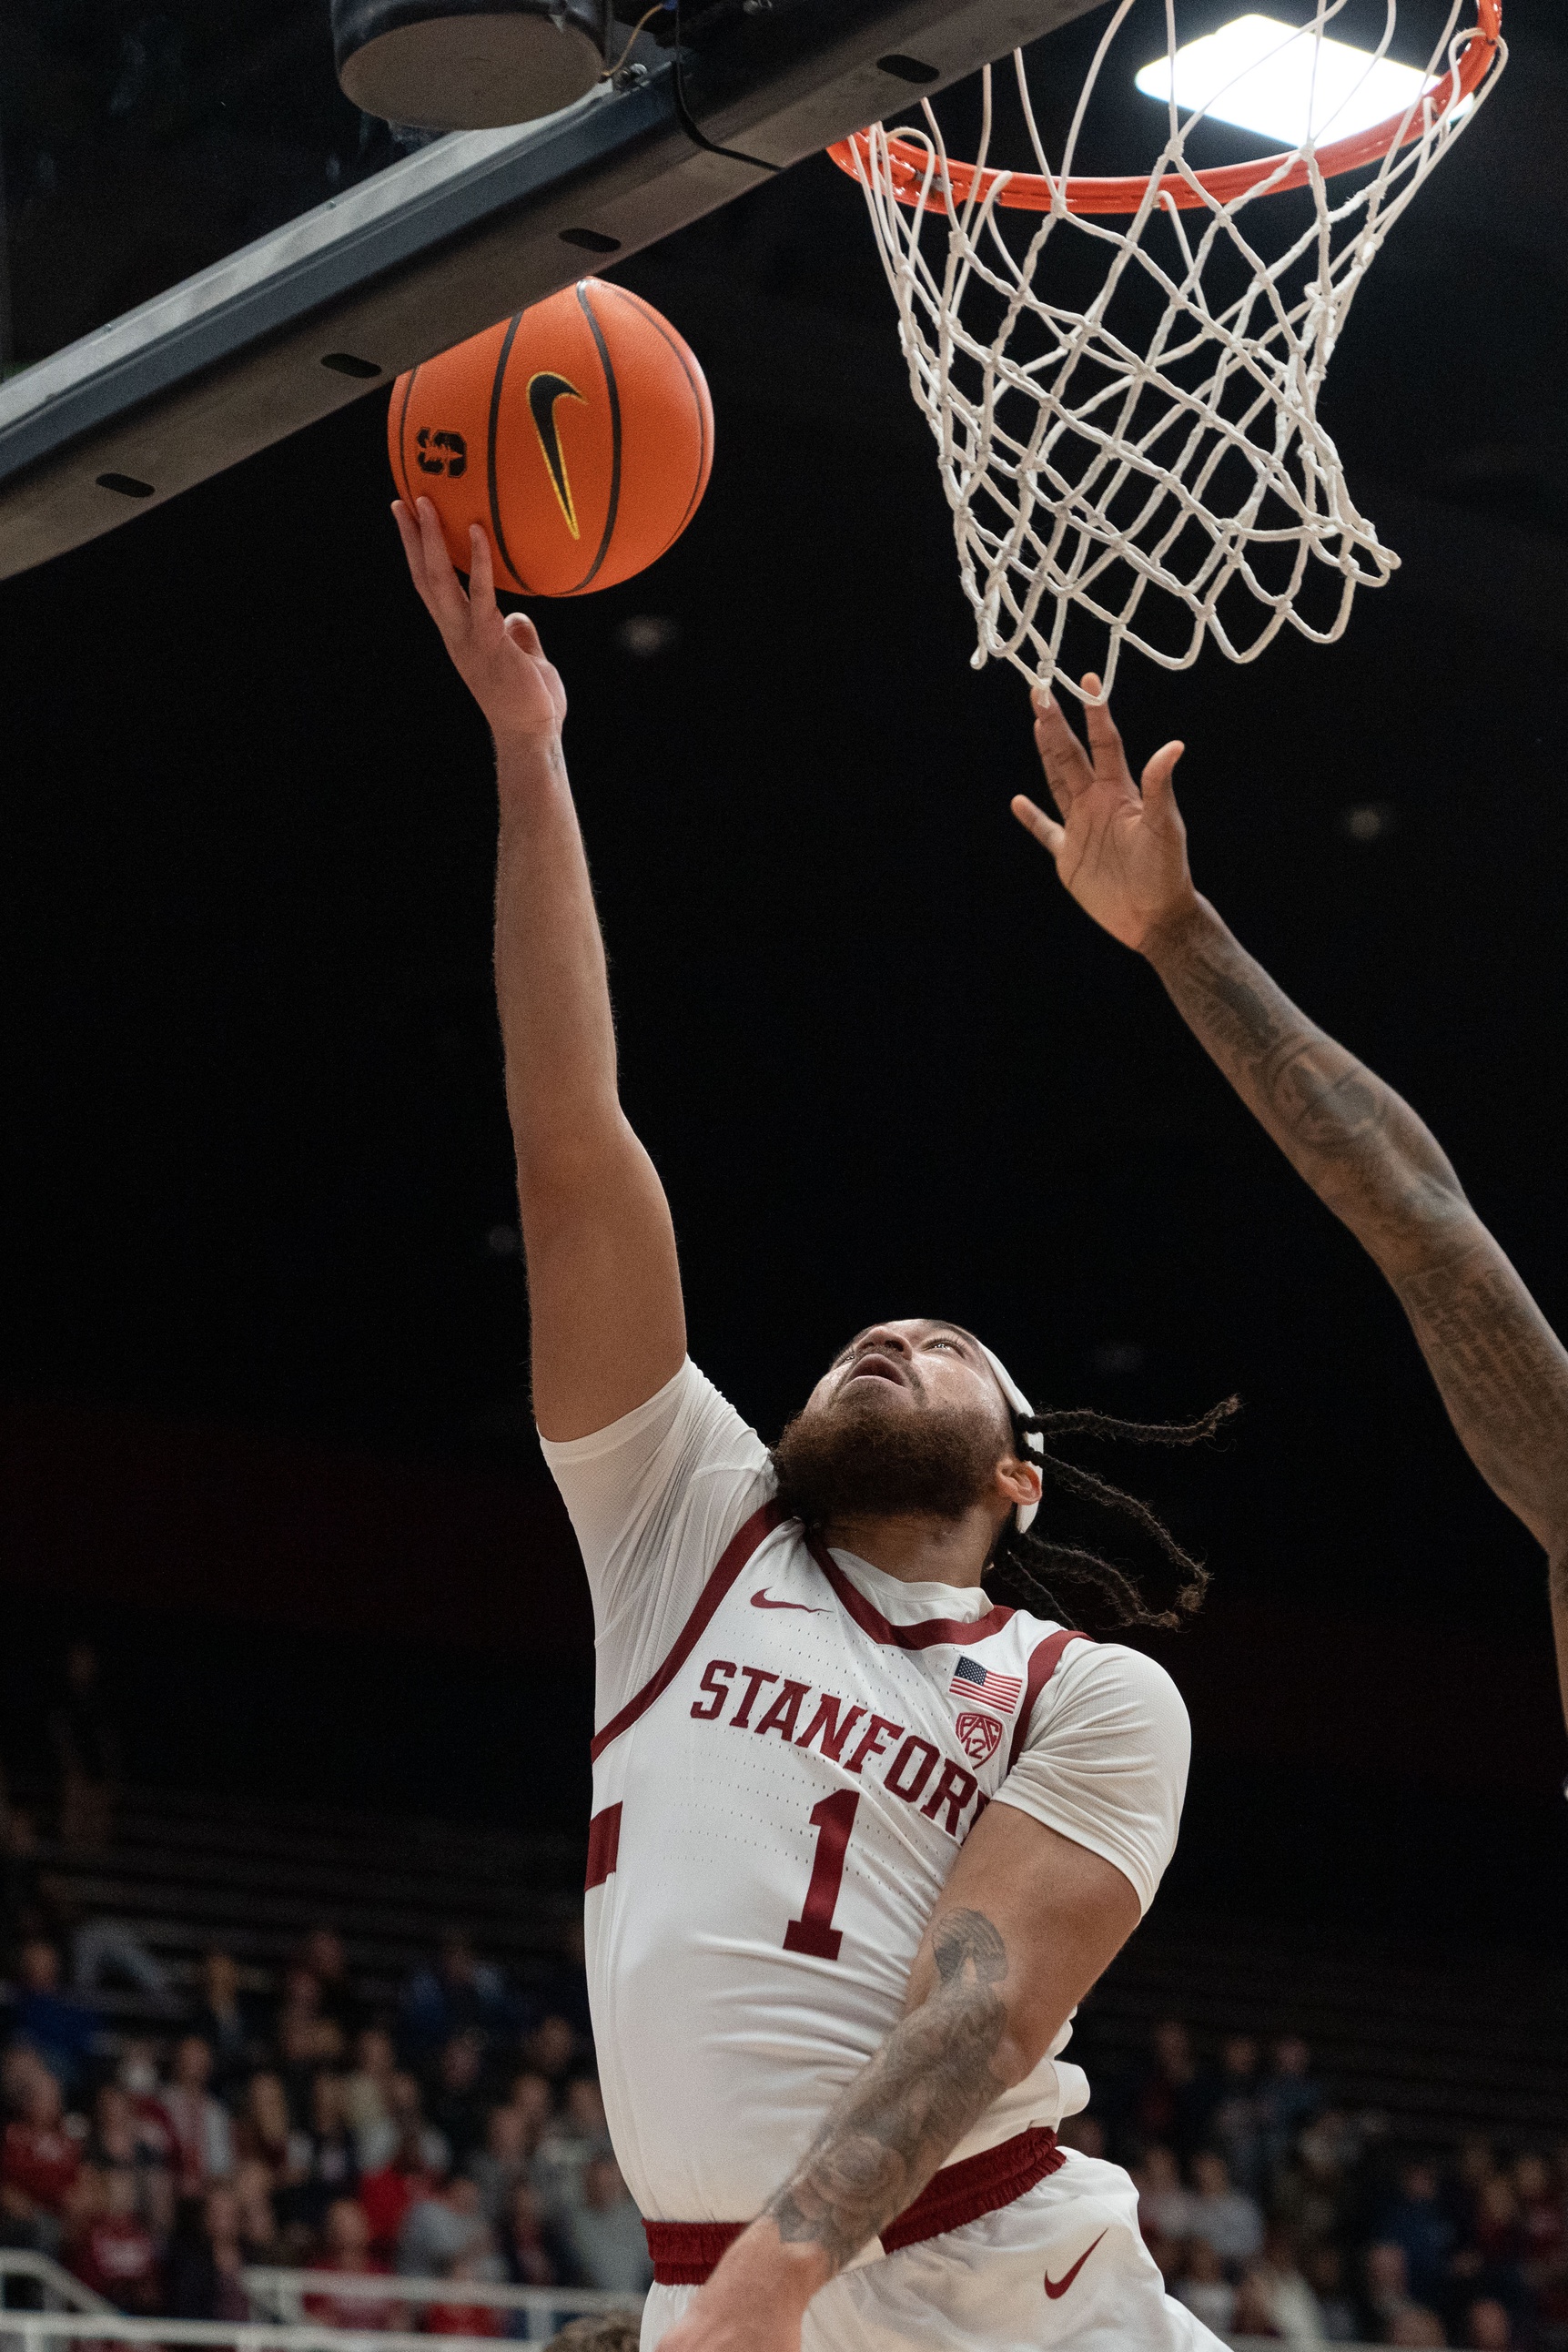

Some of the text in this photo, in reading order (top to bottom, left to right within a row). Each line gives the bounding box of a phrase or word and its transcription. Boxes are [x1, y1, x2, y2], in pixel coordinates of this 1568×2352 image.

[958, 1714, 1001, 1751] PAC
[965, 1737, 986, 1759] 12
[783, 1789, 860, 1961] 1
